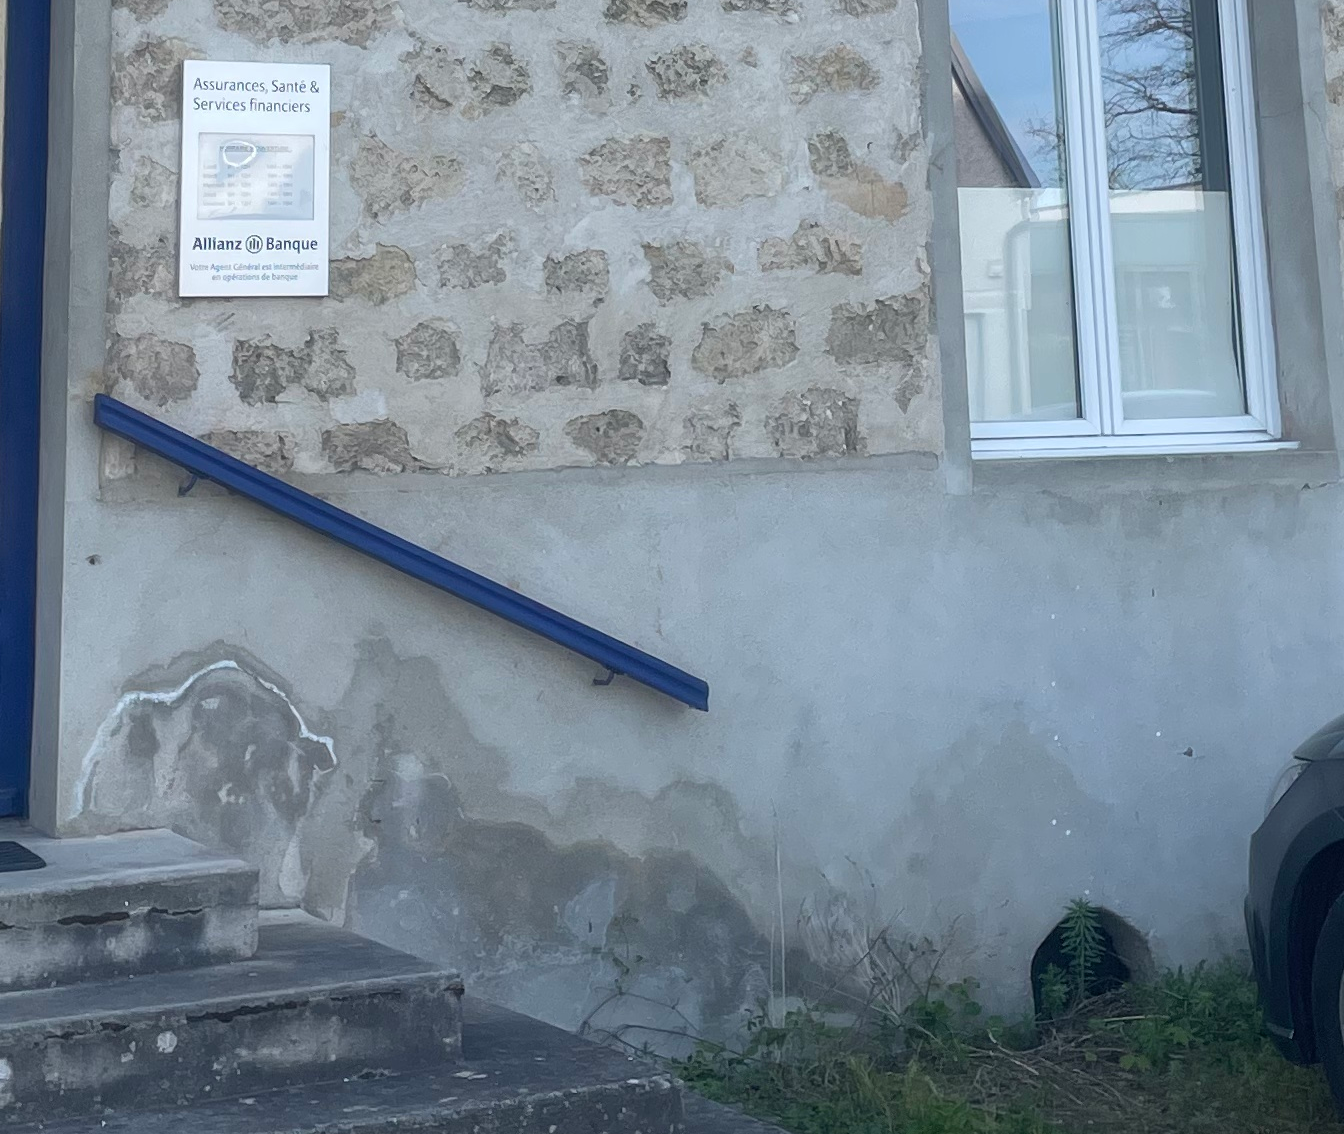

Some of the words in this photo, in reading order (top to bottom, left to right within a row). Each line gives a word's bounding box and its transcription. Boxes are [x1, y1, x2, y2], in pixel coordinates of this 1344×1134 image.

[193, 78, 268, 94] Assurances,
[272, 80, 306, 93] Santé
[310, 81, 319, 93] &
[193, 97, 246, 111] Services
[250, 98, 310, 113] financiers
[192, 237, 242, 251] Allianz
[266, 237, 318, 253] Banque
